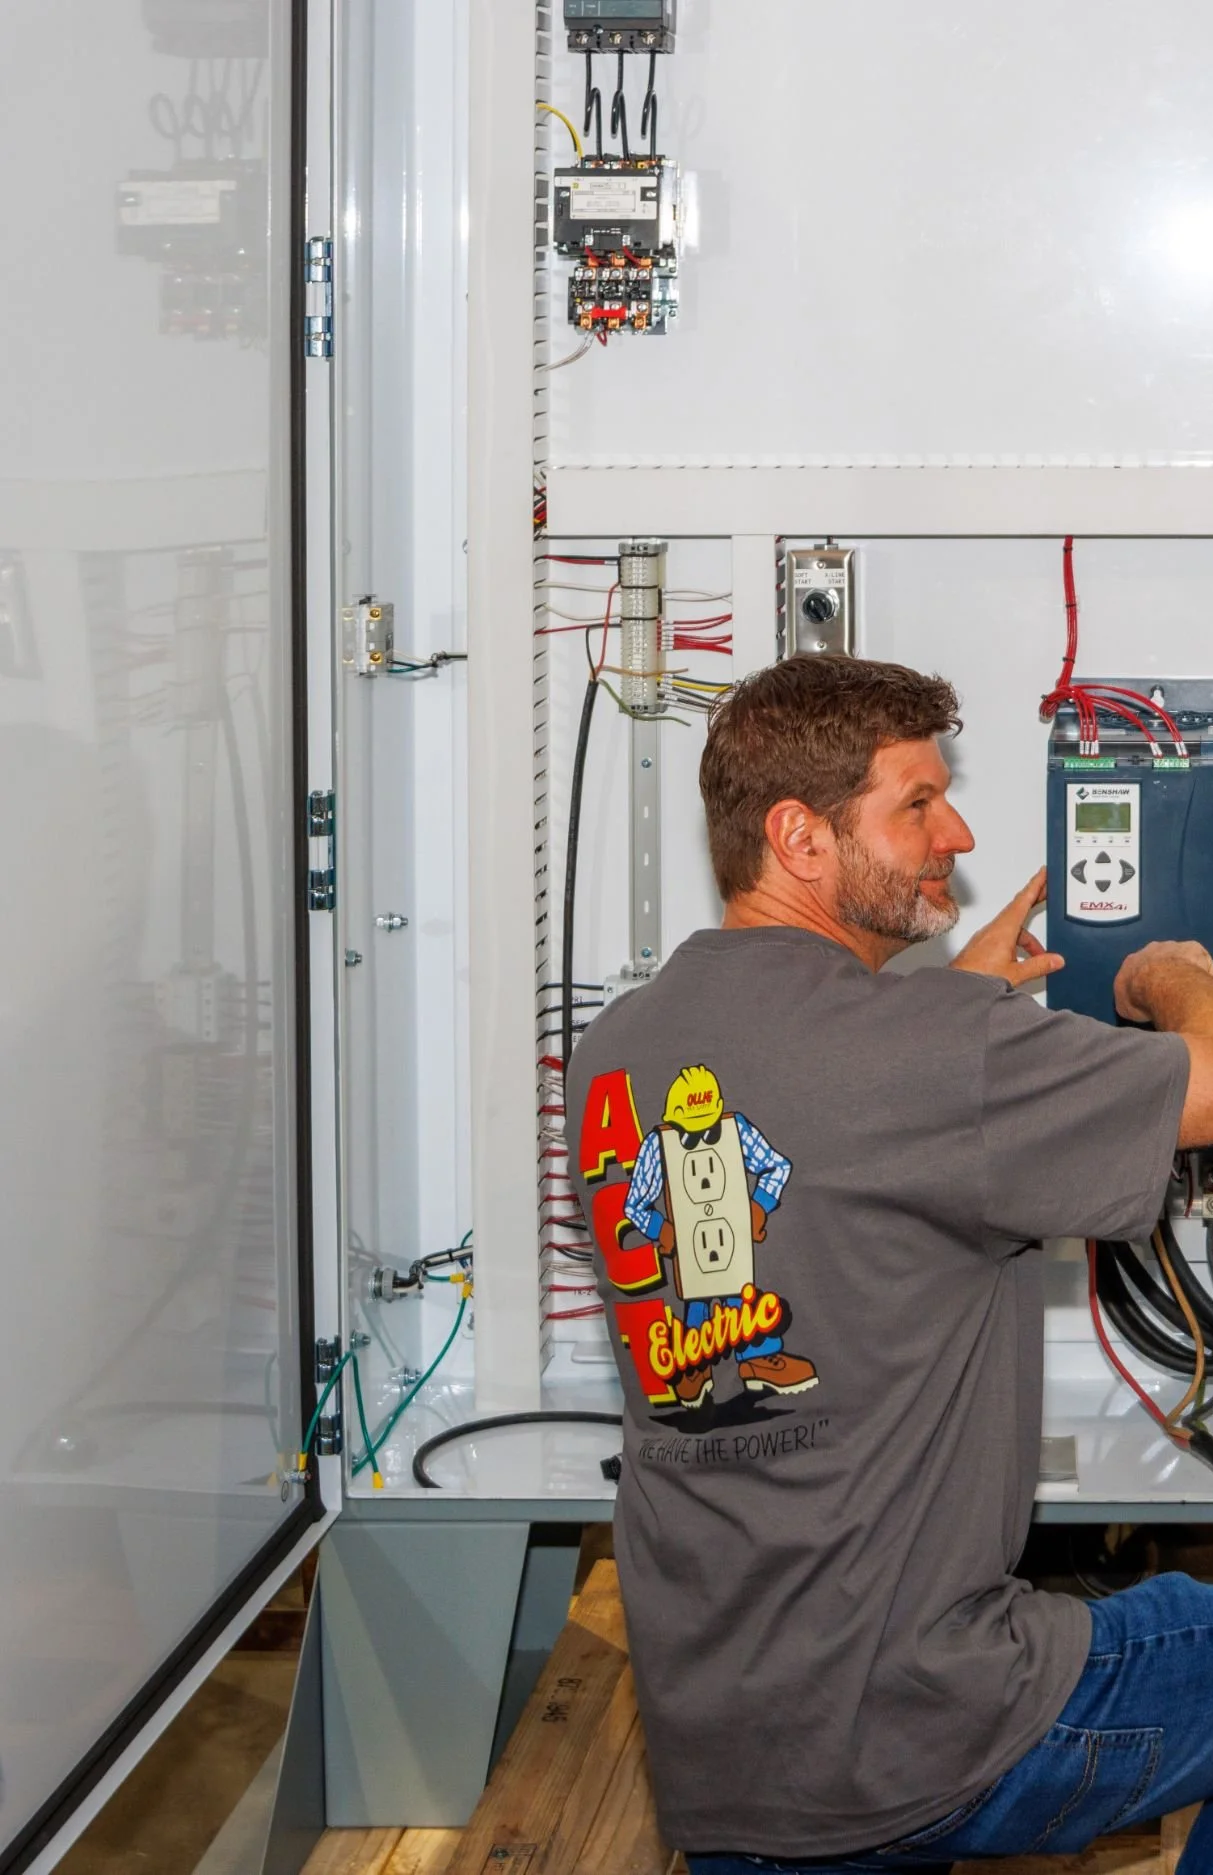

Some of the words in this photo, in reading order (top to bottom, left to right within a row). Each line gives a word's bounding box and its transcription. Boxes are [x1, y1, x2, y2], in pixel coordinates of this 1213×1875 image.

[648, 1281, 784, 1380] Electric
[656, 1438, 692, 1464] HAVE
[695, 1437, 726, 1464] THE
